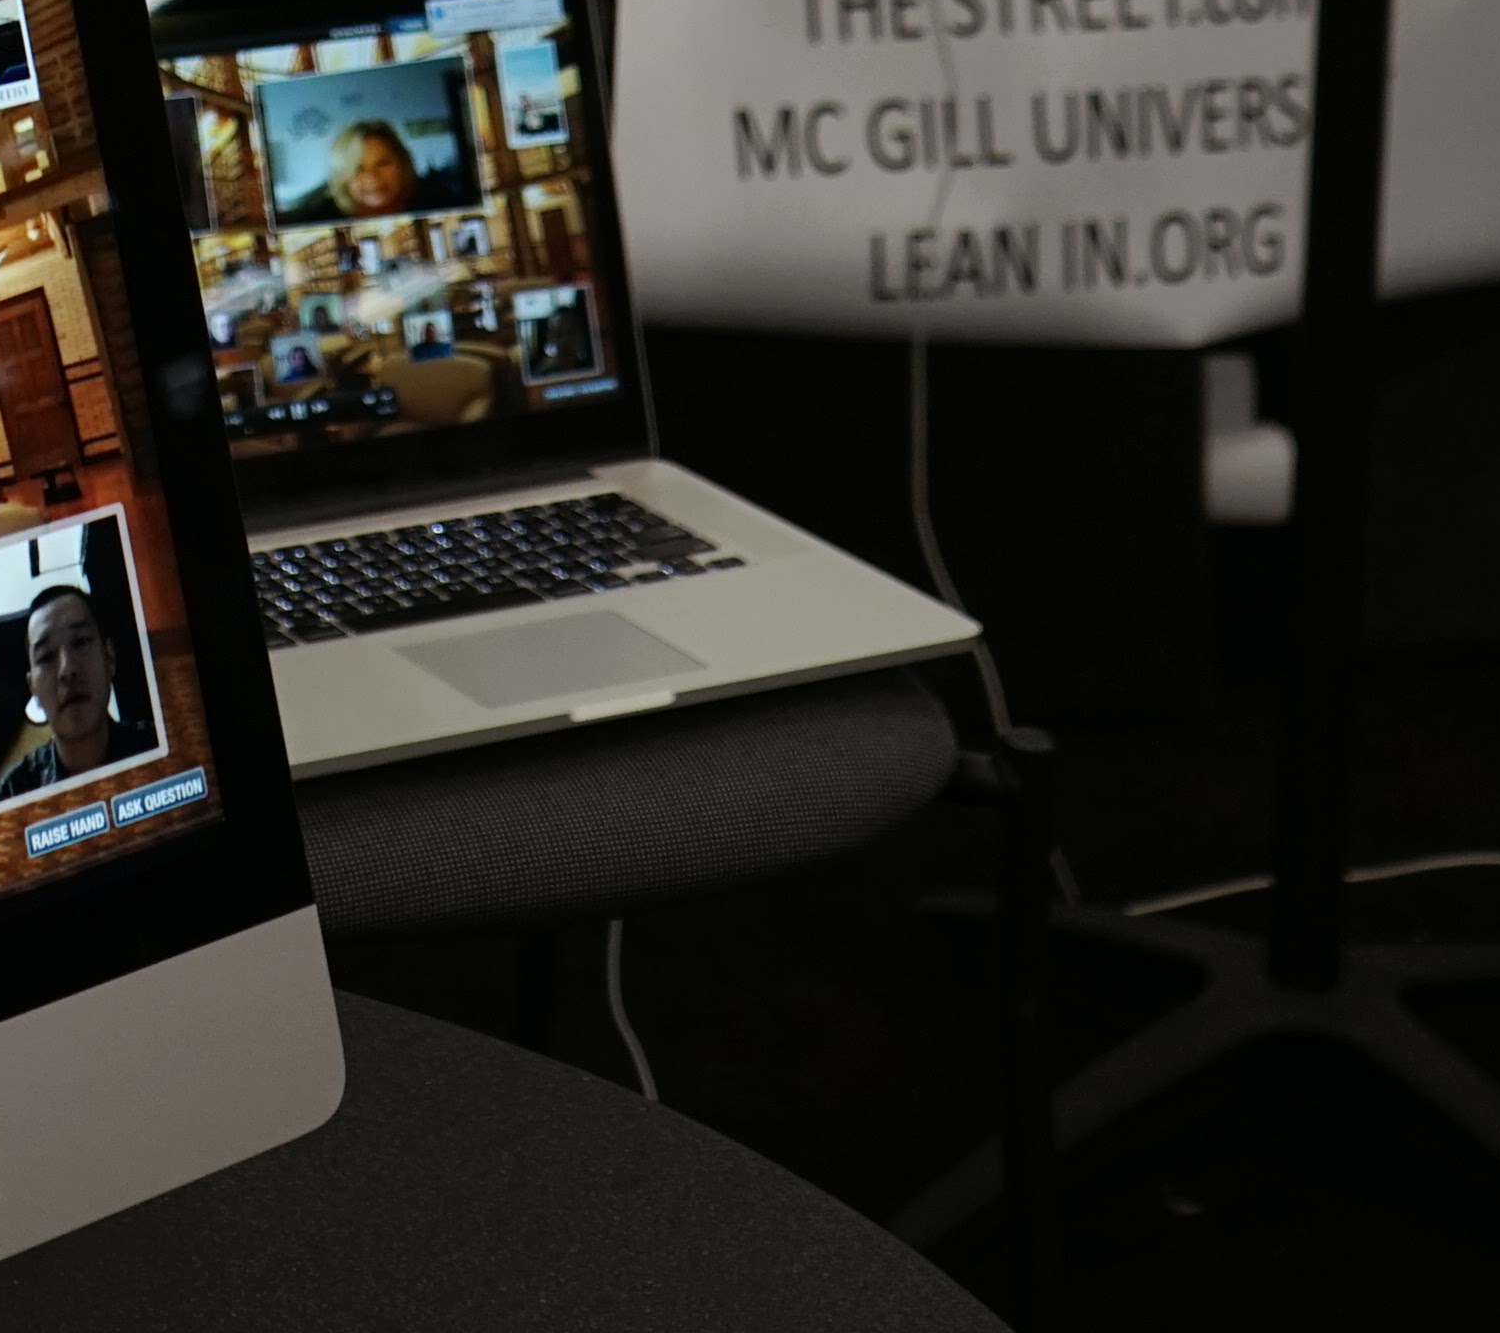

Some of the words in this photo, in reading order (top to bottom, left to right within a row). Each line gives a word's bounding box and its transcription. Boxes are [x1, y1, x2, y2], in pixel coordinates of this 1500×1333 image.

[730, 99, 849, 178] MC
[865, 91, 1018, 174] GILL
[863, 222, 1043, 308] LEAN
[1056, 199, 1289, 302] IN.ORG
[118, 799, 144, 821] ASK
[144, 777, 204, 812] QUESTION
[31, 823, 70, 852] RAISE
[70, 812, 105, 837] HAND
